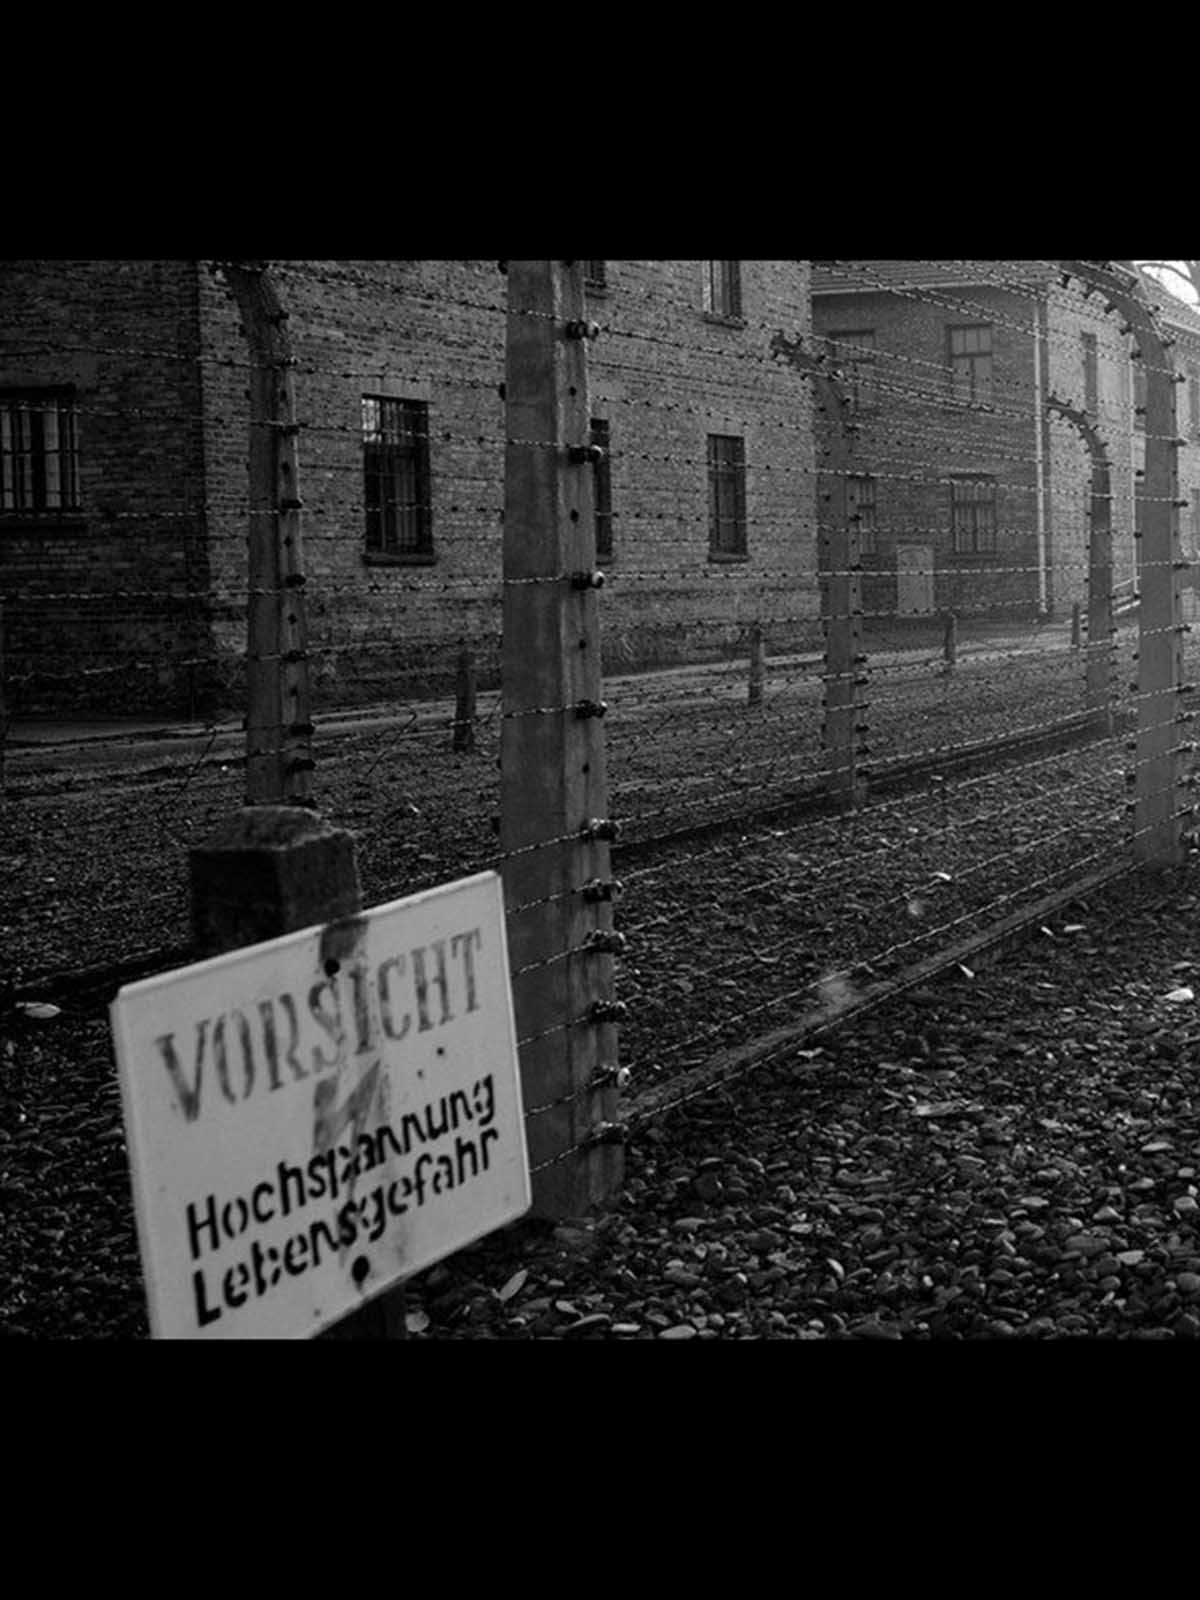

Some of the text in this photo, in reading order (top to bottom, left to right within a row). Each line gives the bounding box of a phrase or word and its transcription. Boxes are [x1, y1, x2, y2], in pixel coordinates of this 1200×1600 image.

[155, 927, 483, 1124] VORSICHT
[186, 1074, 496, 1260] Hochspannung
[192, 1128, 499, 1328] Lebensgefahr
